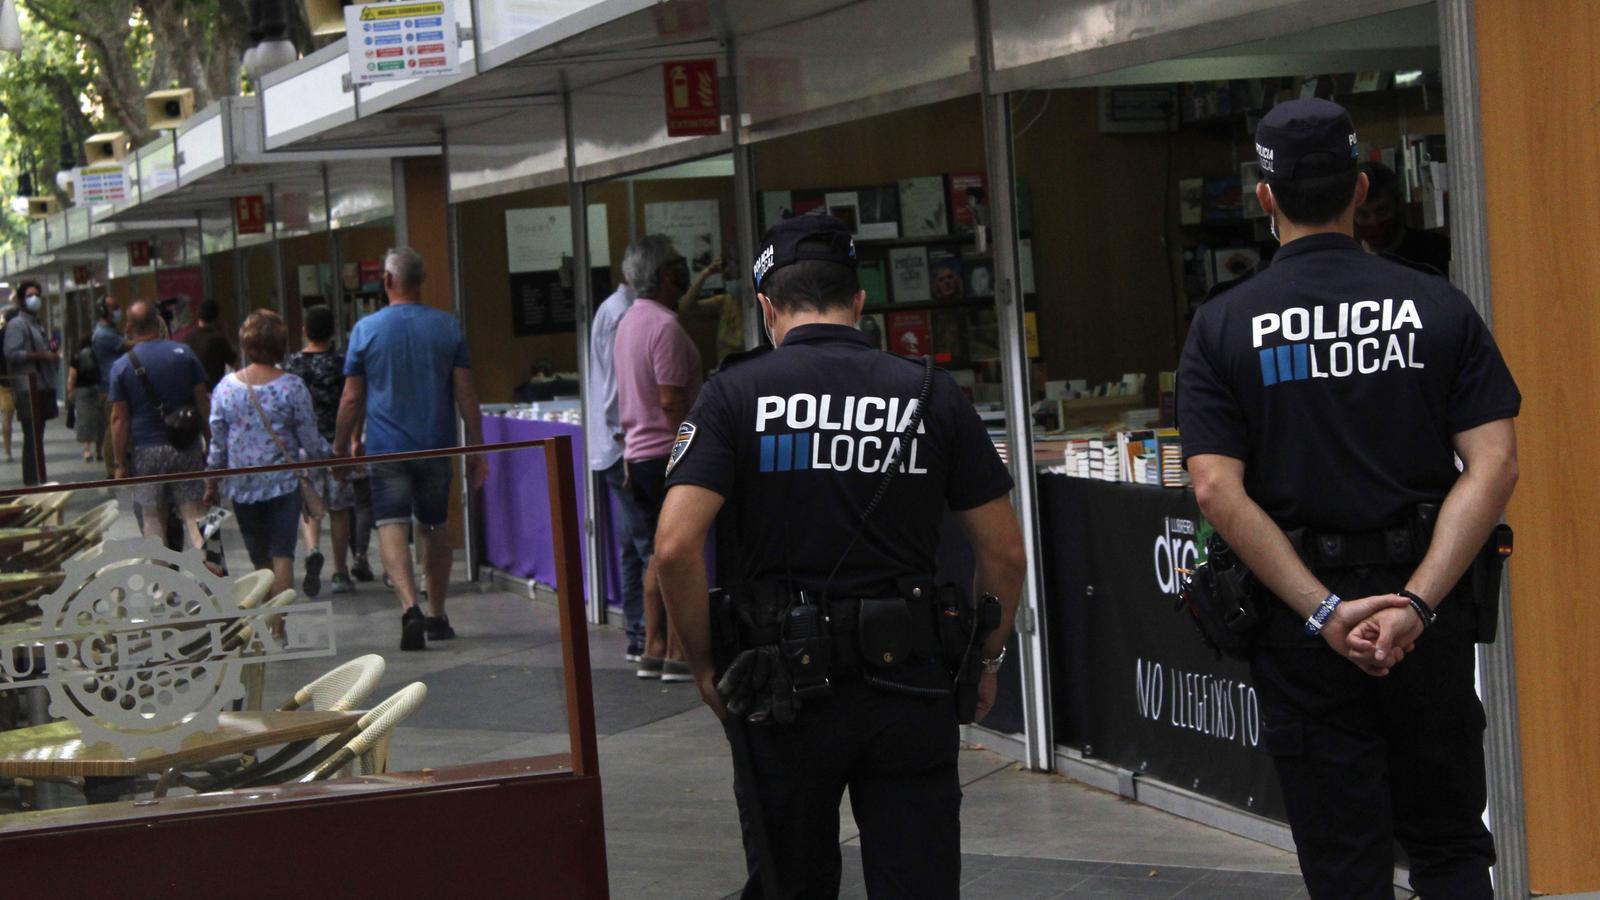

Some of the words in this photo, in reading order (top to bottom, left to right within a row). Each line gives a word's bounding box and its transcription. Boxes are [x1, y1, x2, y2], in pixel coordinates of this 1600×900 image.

[1252, 298, 1423, 348] POLICIA
[1309, 332, 1425, 378] LOCAL
[755, 393, 926, 434] POLICIA
[812, 432, 928, 474] LOCAL
[0, 627, 190, 678] URGER
[205, 610, 319, 657] LAB
[1136, 657, 1163, 720] NO
